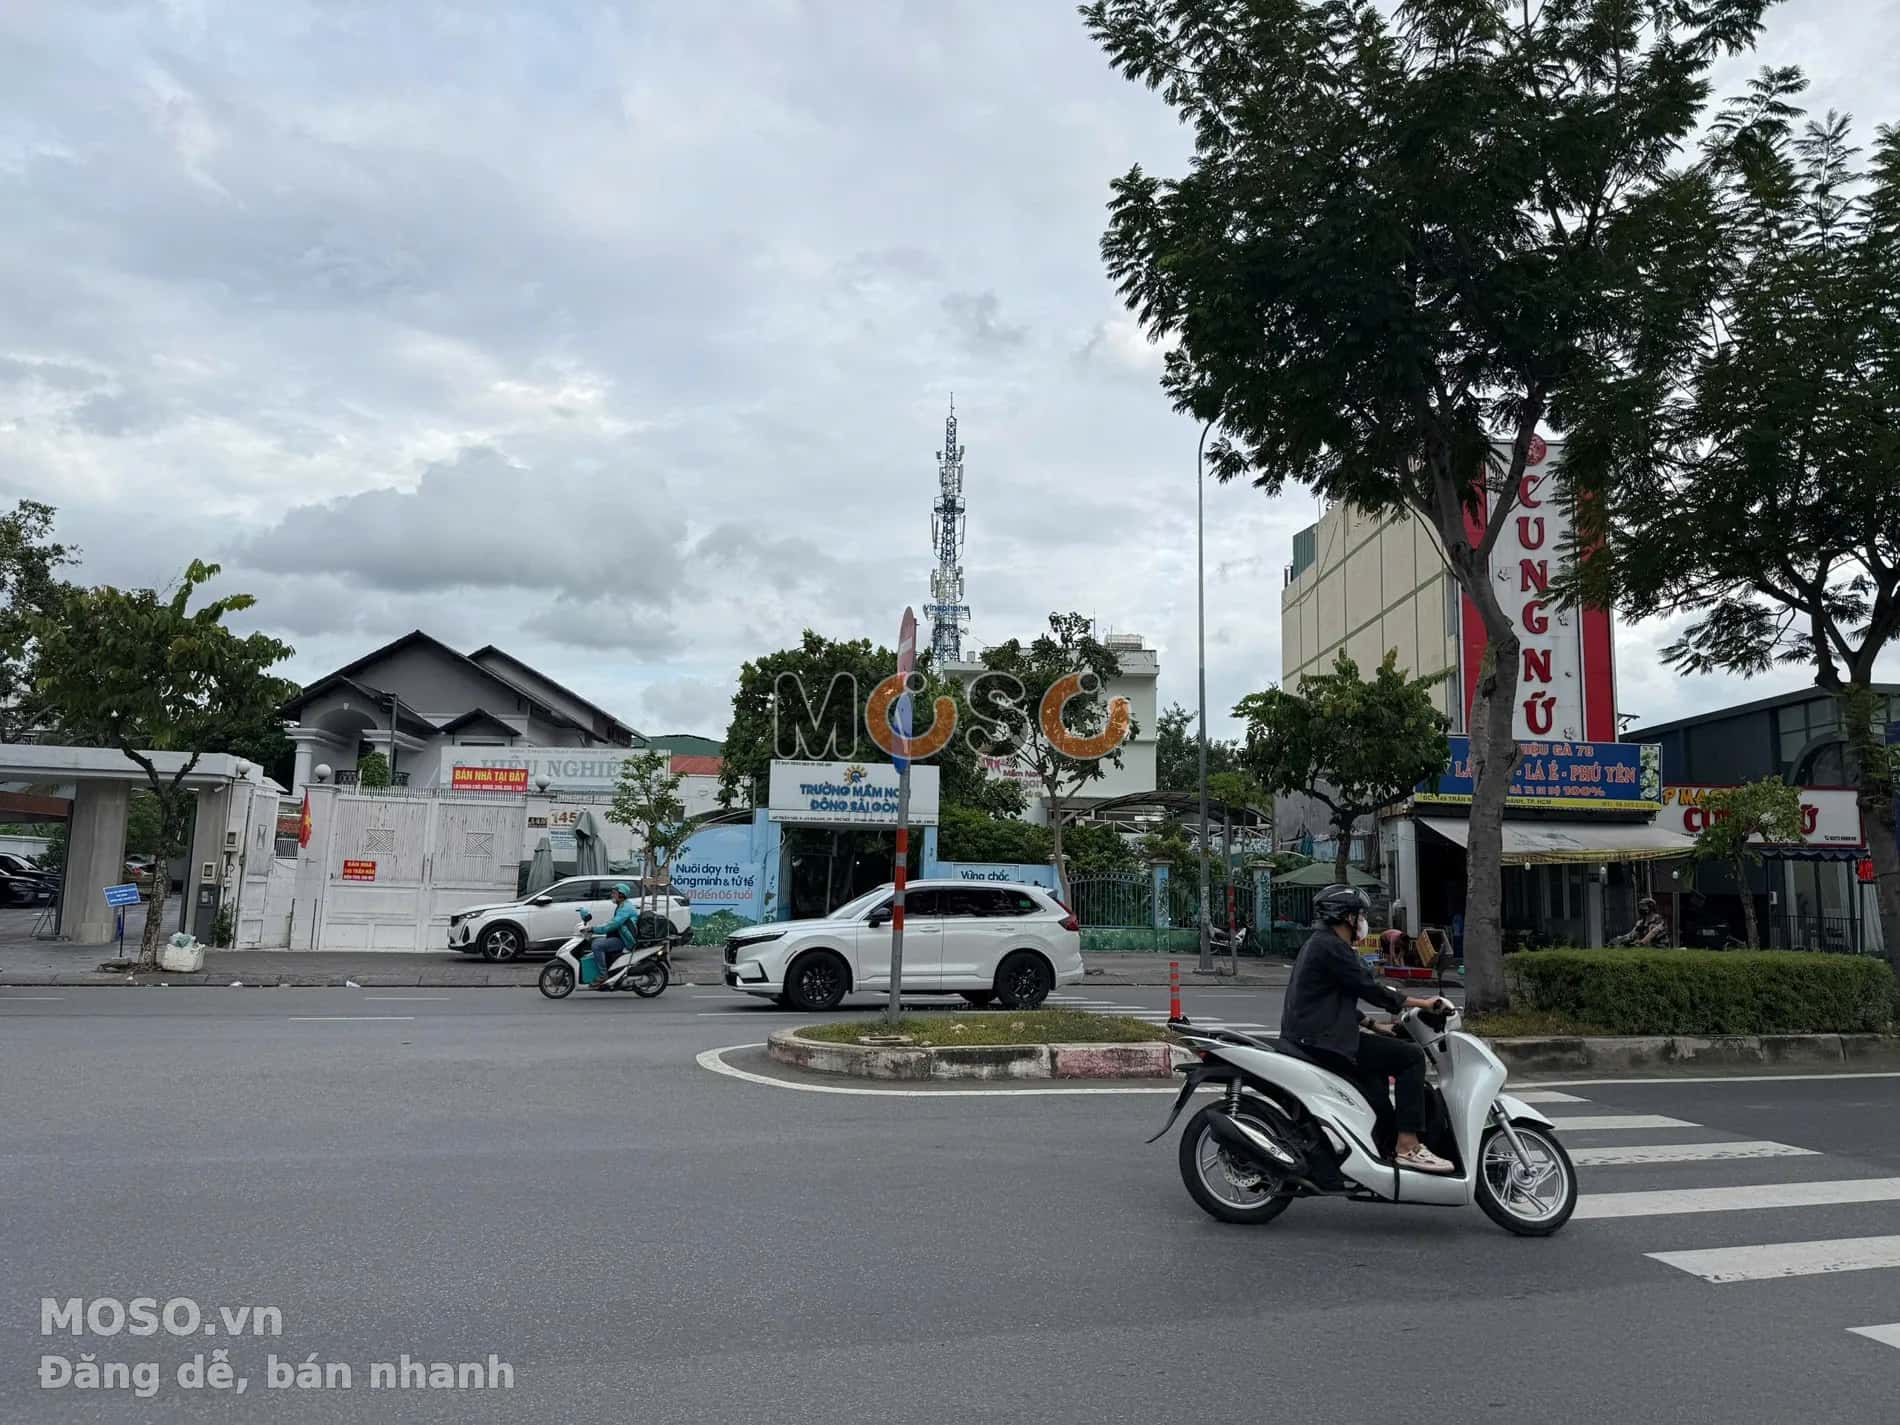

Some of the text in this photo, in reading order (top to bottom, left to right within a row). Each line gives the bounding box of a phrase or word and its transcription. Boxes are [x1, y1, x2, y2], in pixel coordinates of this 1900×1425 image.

[1516, 474, 1556, 736] CUNG NỮ
[1552, 743, 1573, 757] GÀ
[455, 768, 473, 780] BÁN
[475, 768, 493, 781] NHÀ
[495, 770, 507, 784] TẠI
[1525, 760, 1546, 781] LÁ
[1570, 761, 1601, 782] PHÚ
[1605, 763, 1636, 784] YÊN
[800, 781, 850, 796] TRƯỜNG
[884, 787, 900, 798] NO
[811, 797, 848, 811] ĐÔNG
[850, 798, 869, 812] SÀI
[676, 863, 740, 876] Nuôi dạy trẻ
[671, 875, 696, 887] hông
